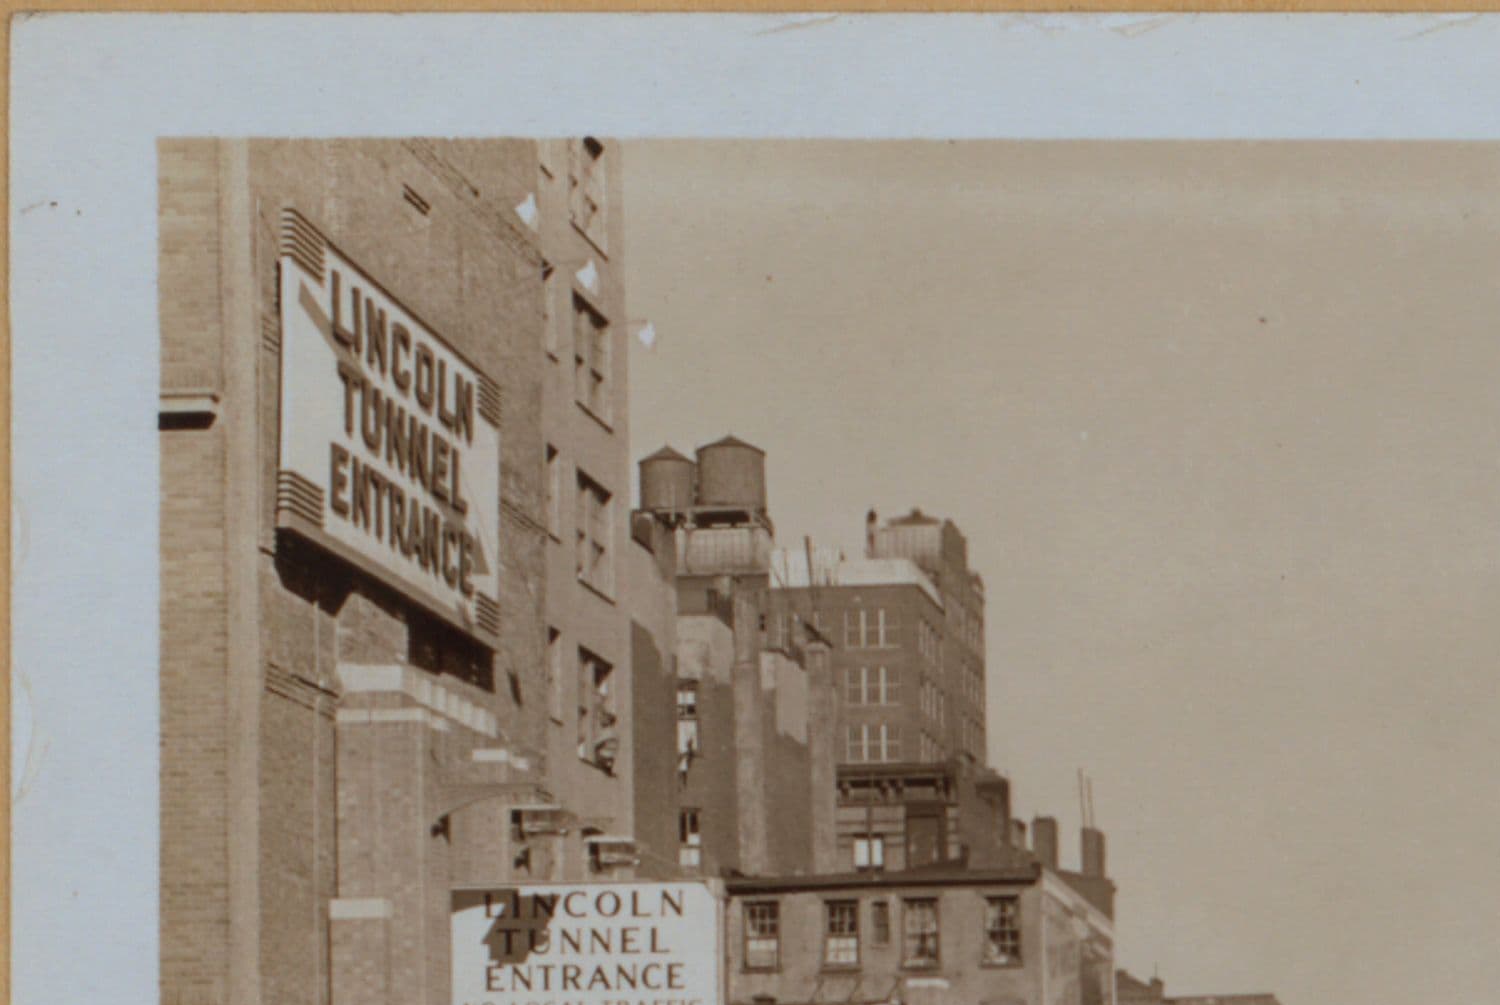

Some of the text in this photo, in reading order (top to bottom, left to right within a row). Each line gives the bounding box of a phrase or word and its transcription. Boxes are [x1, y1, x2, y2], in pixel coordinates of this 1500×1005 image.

[331, 268, 474, 448] LINCOLN
[338, 361, 468, 516] TUNNEL
[330, 441, 475, 592] ENTRANCE
[483, 889, 684, 919] LINCOLN
[497, 927, 670, 955] TUNNEL
[485, 962, 686, 992] ENTRANCE
